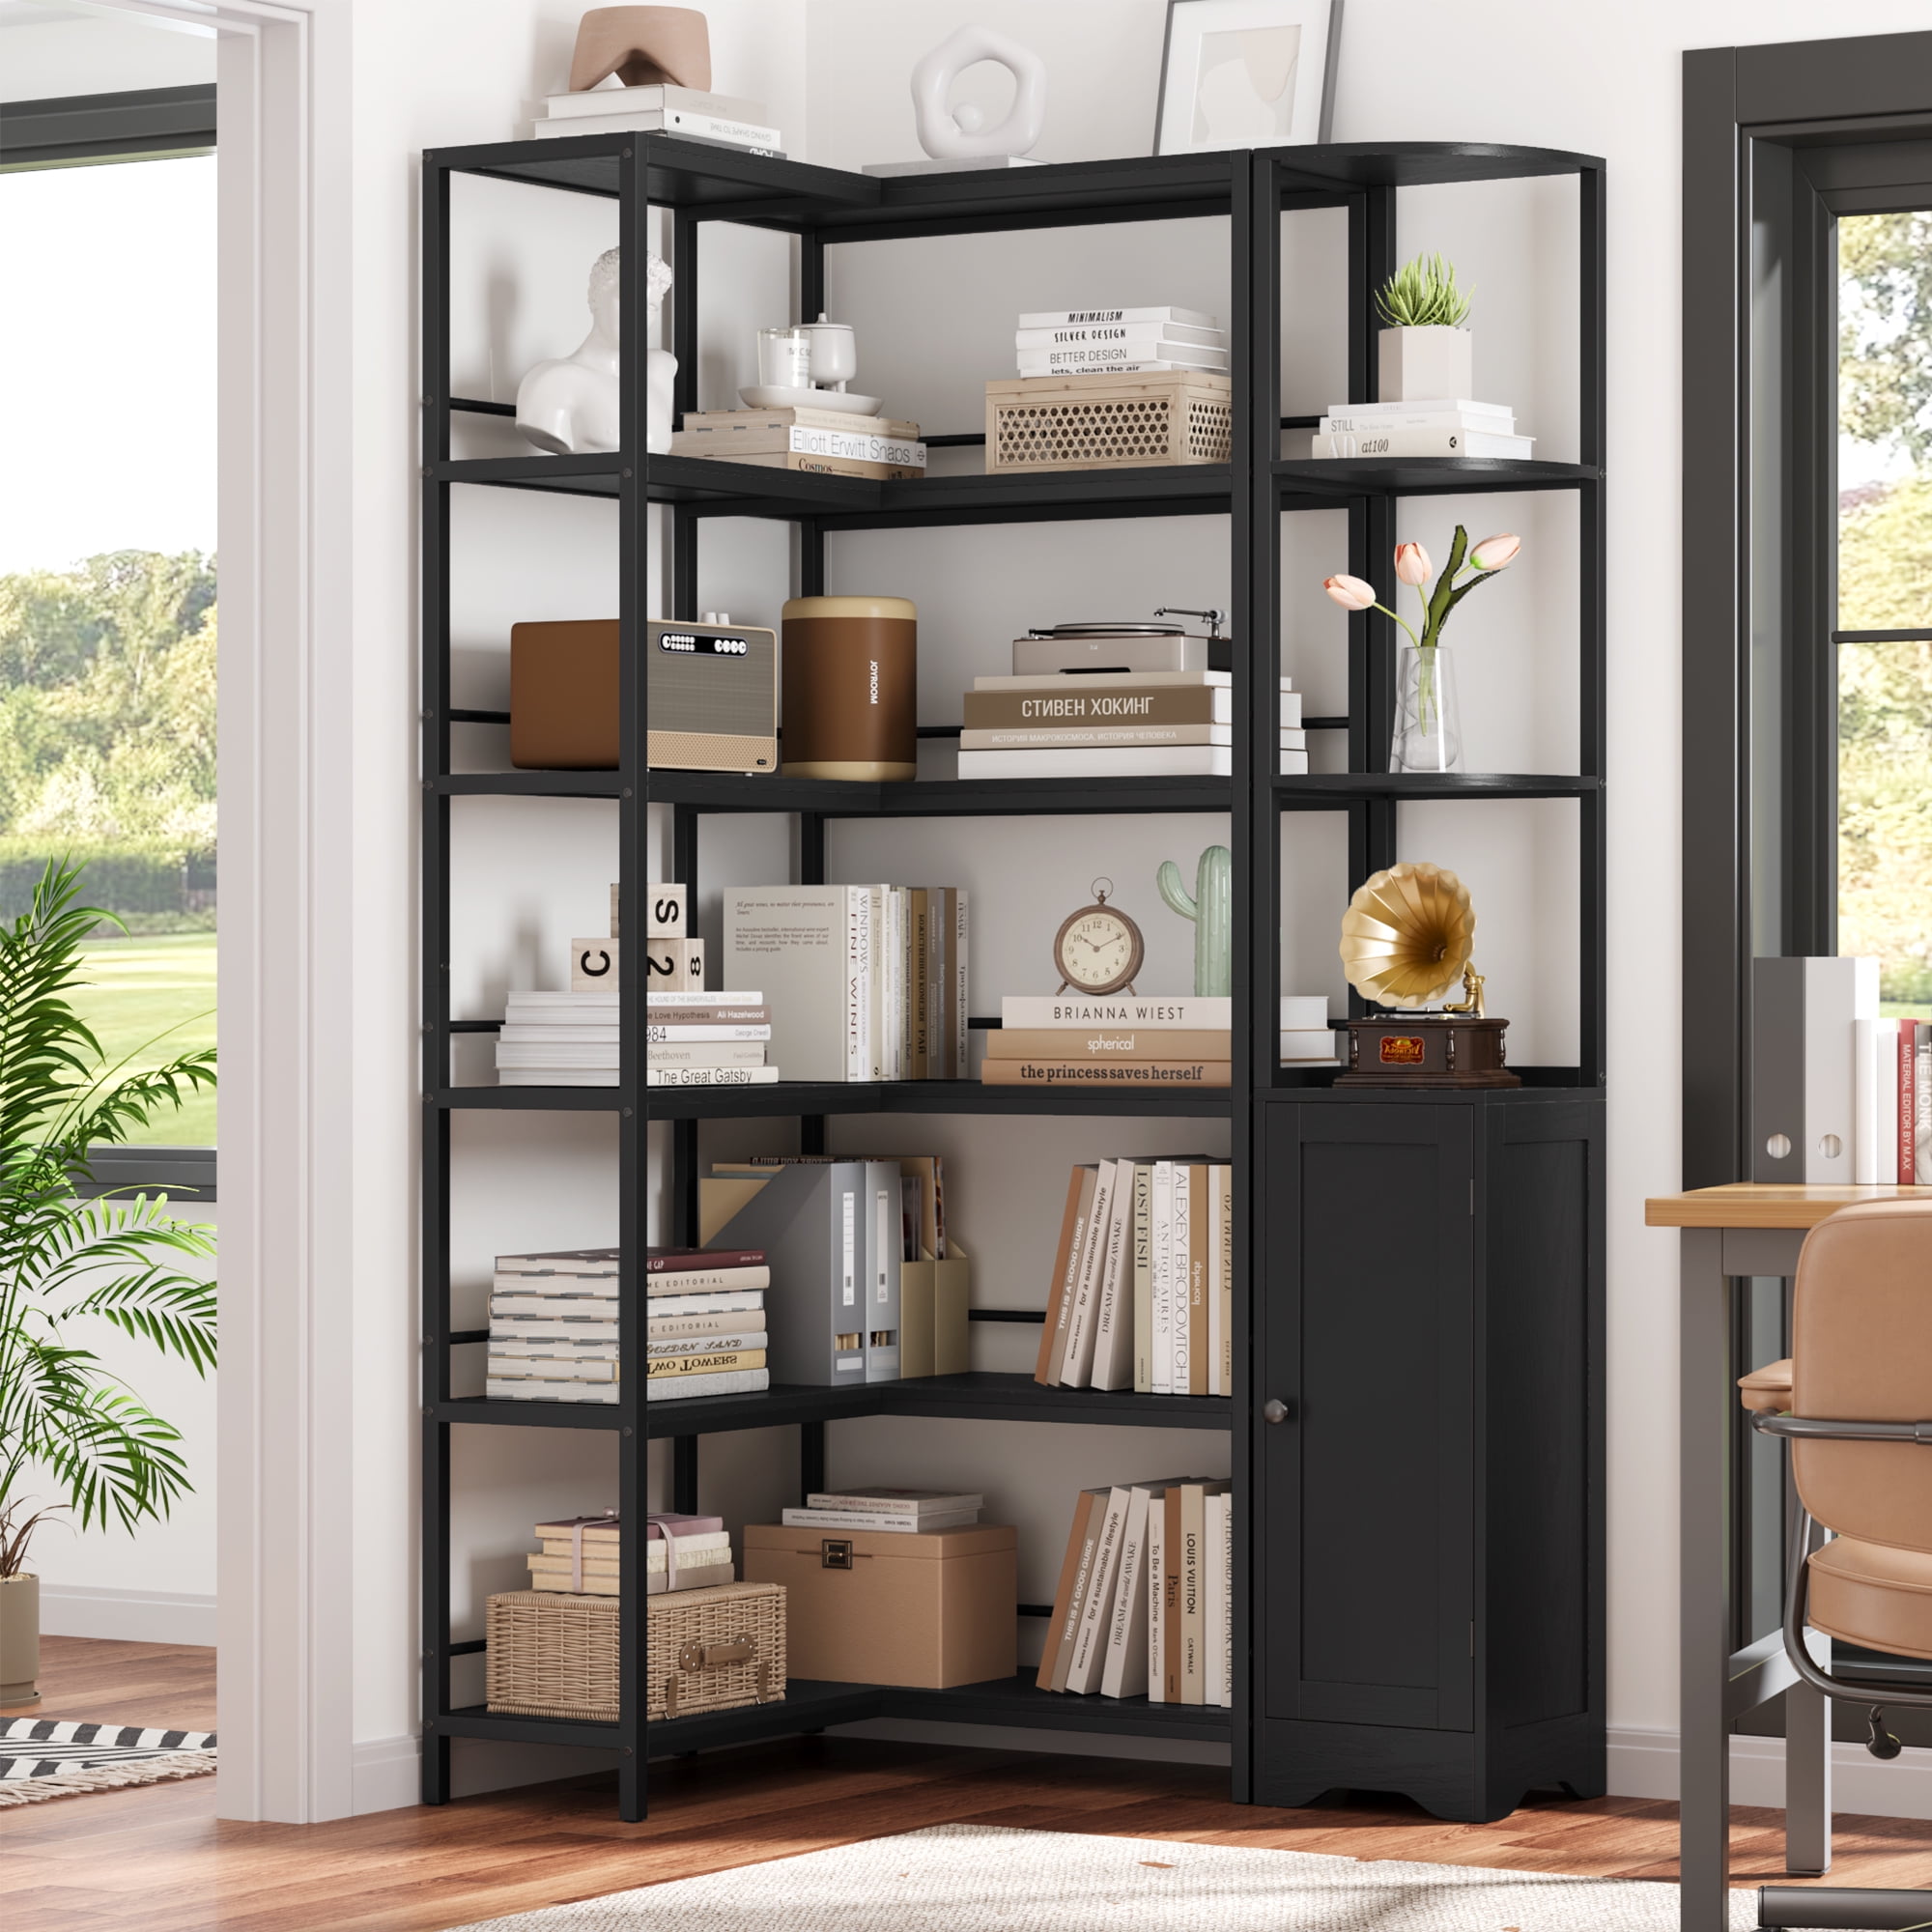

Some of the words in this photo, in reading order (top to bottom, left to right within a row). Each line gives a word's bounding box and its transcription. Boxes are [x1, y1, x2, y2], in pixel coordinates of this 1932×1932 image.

[1067, 311, 1122, 324] MINIMALISM
[1054, 329, 1086, 343] SILVER
[1092, 328, 1126, 340] DESIGN
[1050, 351, 1086, 364] BETTER
[1089, 349, 1127, 362] DESIGN
[1331, 419, 1354, 432] STILL
[794, 430, 827, 453] Elliott
[831, 435, 866, 458] Erwitt
[870, 439, 910, 464] Snaps
[1362, 439, 1389, 453] at100
[798, 458, 833, 473] Cosmos
[870, 660, 879, 704] JOYROOM
[1022, 698, 1085, 717] СТИВЕН
[1091, 696, 1154, 716] ХОКИНГ
[991, 733, 1028, 743] ИСТОРИЯ
[1097, 731, 1134, 741] ИСТОРИЯ
[655, 898, 678, 923] S
[860, 895, 868, 973] WINDOWS
[1093, 921, 1102, 929] 12
[1107, 923, 1111, 932] 1
[1073, 934, 1082, 943] 10
[1068, 946, 1074, 954] 9
[581, 951, 611, 977] C
[647, 956, 674, 976] 2
[691, 956, 701, 976] 8
[1082, 968, 1088, 977] 7
[1105, 967, 1111, 976] 5
[1093, 970, 1098, 979] 6
[673, 1011, 710, 1020] Hypothesis
[717, 1010, 725, 1019] Ali
[727, 1010, 765, 1019] Hazelwood
[1053, 1007, 1128, 1020] BRIANNA
[1136, 1007, 1185, 1020] WIEST
[918, 1029, 926, 1055] РАЙ
[1087, 1035, 1134, 1054] spherical
[648, 1050, 691, 1061] Beethoven
[1918, 1042, 1932, 1075] THE
[657, 1069, 678, 1085] The
[681, 1069, 711, 1084] Great
[715, 1067, 753, 1083] Gatsby
[1021, 1065, 1044, 1079] the
[1046, 1065, 1108, 1083] princess
[1109, 1068, 1150, 1080] saves
[1151, 1065, 1205, 1081] herself
[1902, 1044, 1912, 1092] MATERIAL
[1902, 1094, 1912, 1129] EDITOR
[1918, 1080, 1932, 1130] MONK
[1902, 1131, 1912, 1145] BY
[1137, 1173, 1148, 1221] LOST
[1175, 1172, 1187, 1248] ALEXEY
[1073, 1217, 1085, 1251] GUIDE
[1084, 1227, 1099, 1282] sustainable
[1094, 1187, 1107, 1225] lifestyle
[1137, 1227, 1148, 1267] FISH
[1066, 1251, 1078, 1284] GOOD
[1102, 1292, 1114, 1333] DREAM
[1112, 1218, 1122, 1258] AWAKE
[1160, 1221, 1169, 1333] ANTIQUAIRES
[667, 1277, 724, 1288] EDITORIAL
[1065, 1286, 1072, 1294] A
[1063, 1294, 1070, 1306] IS
[1058, 1306, 1068, 1330] THIS
[1175, 1253, 1188, 1379] BRODOVITCH
[662, 1321, 720, 1332] EDITORIAL
[704, 1339, 742, 1350] SAND
[1082, 1538, 1094, 1570] GUIDE
[1152, 1544, 1159, 1555] To
[1186, 1533, 1196, 1566] LOUIS
[1088, 1607, 1096, 1621] for
[1094, 1548, 1111, 1598] sustainable
[1104, 1513, 1120, 1547] lifestyle
[1152, 1558, 1159, 1571] Be
[1074, 1569, 1087, 1599] GOOD
[1113, 1608, 1126, 1646] DREAM
[1124, 1541, 1137, 1578] AWAKE
[1167, 1575, 1179, 1607] Paris
[1186, 1568, 1196, 1614] VUITTON
[1225, 1583, 1233, 1596] BY
[1069, 1609, 1078, 1620] IS
[1065, 1620, 1075, 1641] THIS
